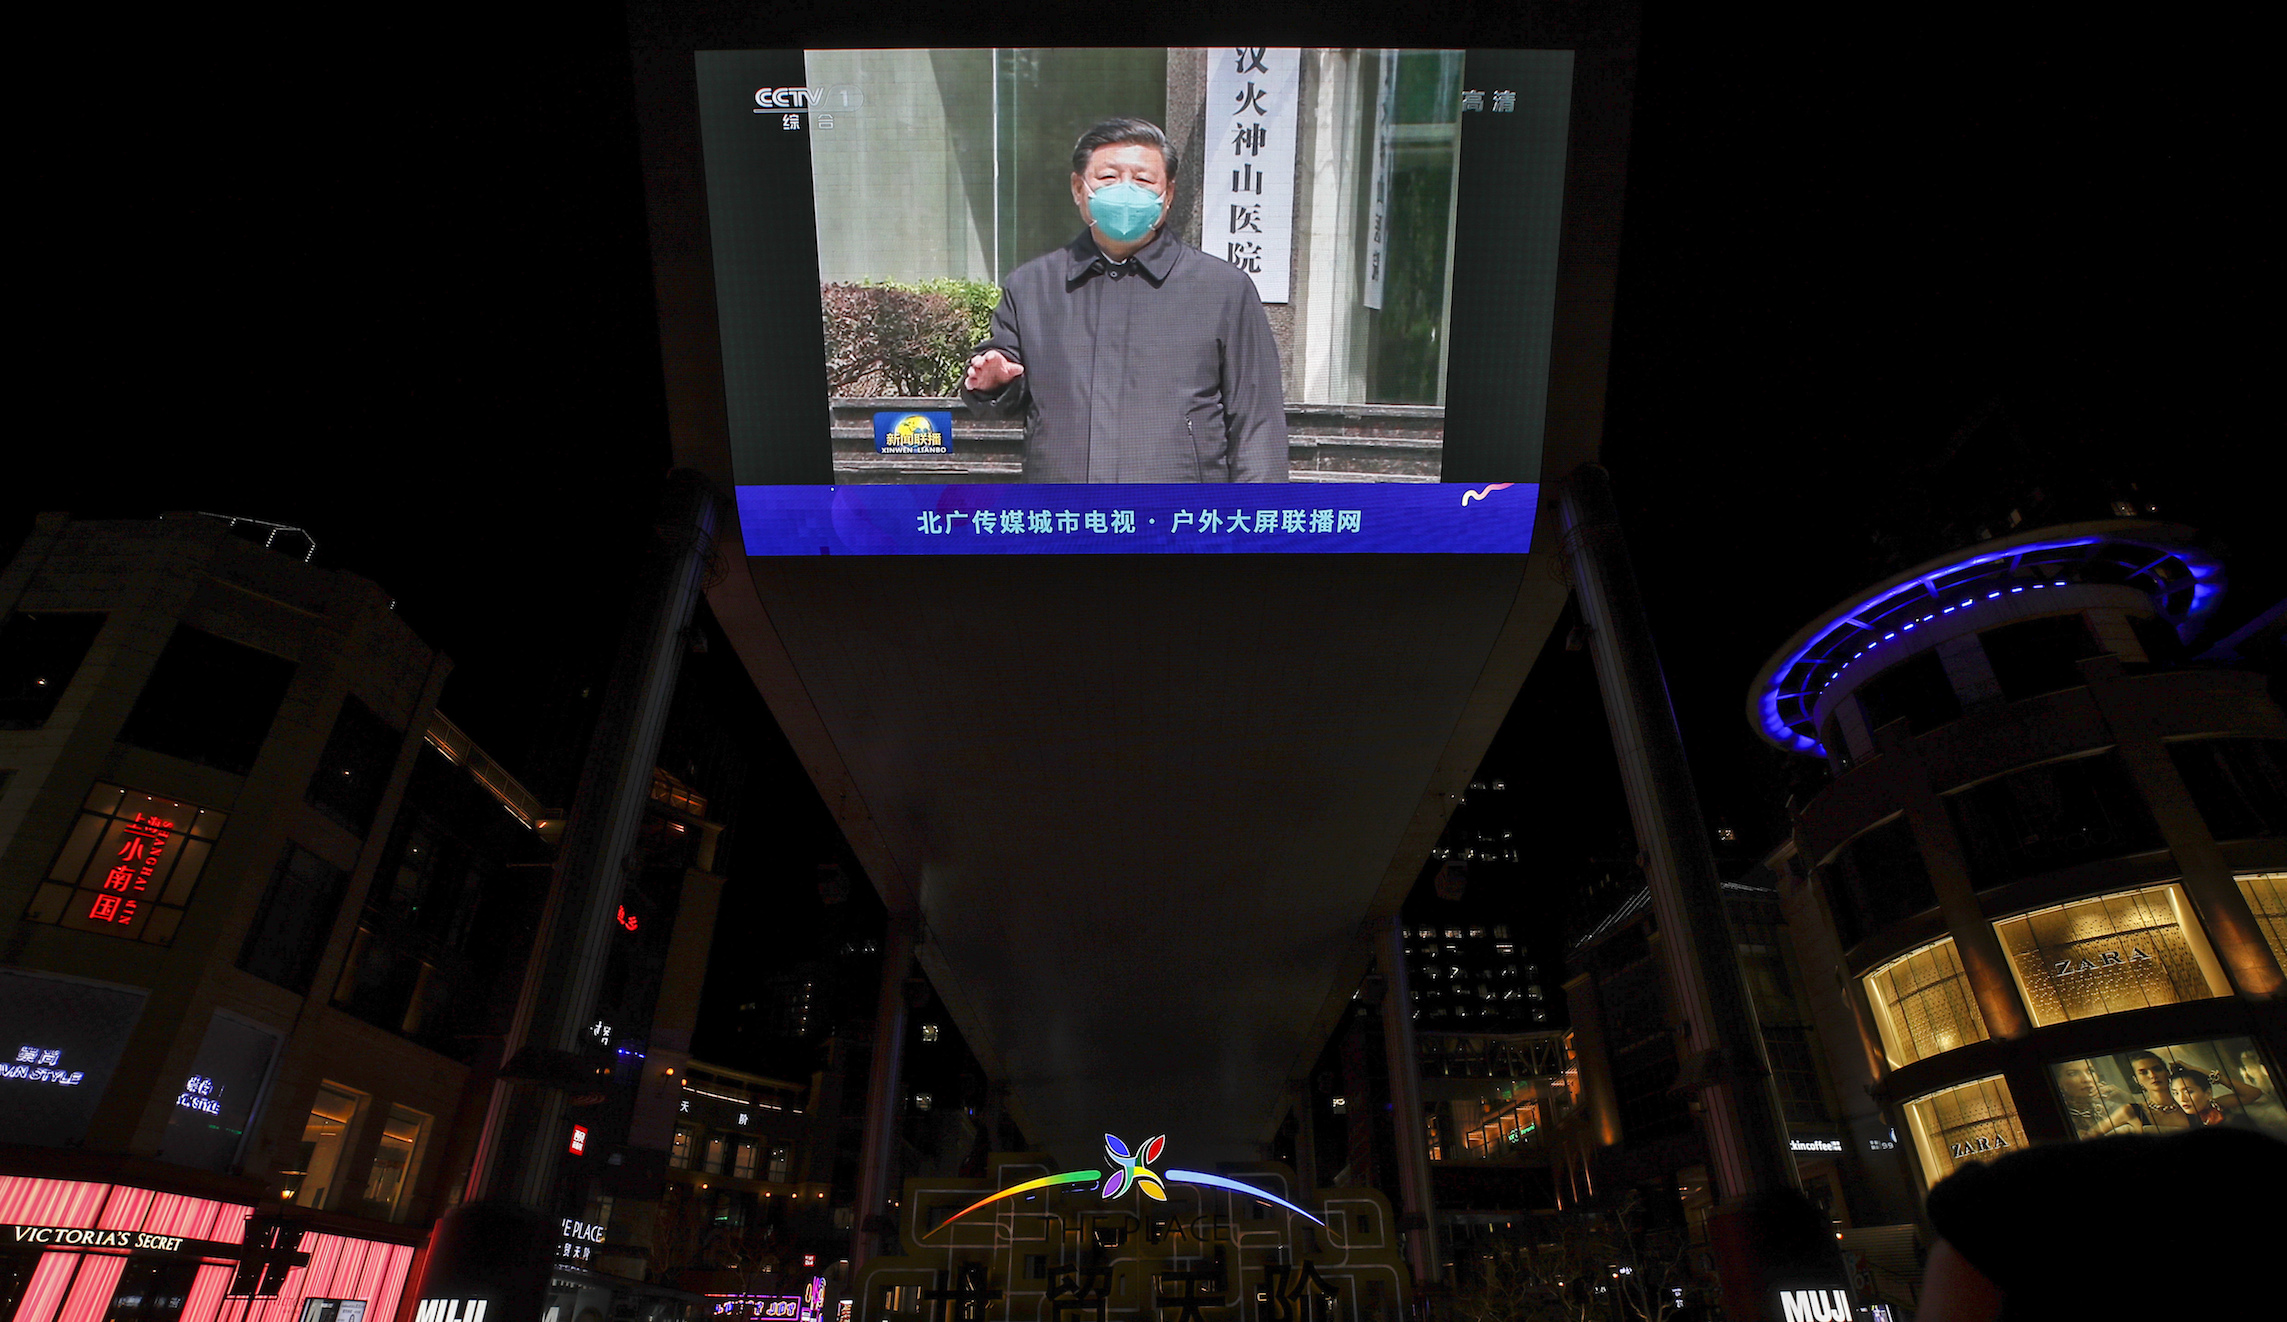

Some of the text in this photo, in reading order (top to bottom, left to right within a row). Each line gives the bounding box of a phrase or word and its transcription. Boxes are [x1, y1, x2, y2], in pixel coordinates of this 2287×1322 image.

[755, 87, 824, 108] CCTV
[1461, 90, 1517, 113] 高清
[782, 113, 834, 130] 综合
[886, 433, 942, 446] 新闻联播
[133, 821, 175, 891] SHANGHAI
[2054, 947, 2153, 978] ZARA
[29, 1067, 85, 1086] STYLE
[1951, 1133, 2011, 1159] ZARA
[14, 1226, 184, 1252] VICTORIA'S SECRET
[572, 1221, 604, 1242] PLACE
[1780, 1290, 1853, 1322] MUJI
